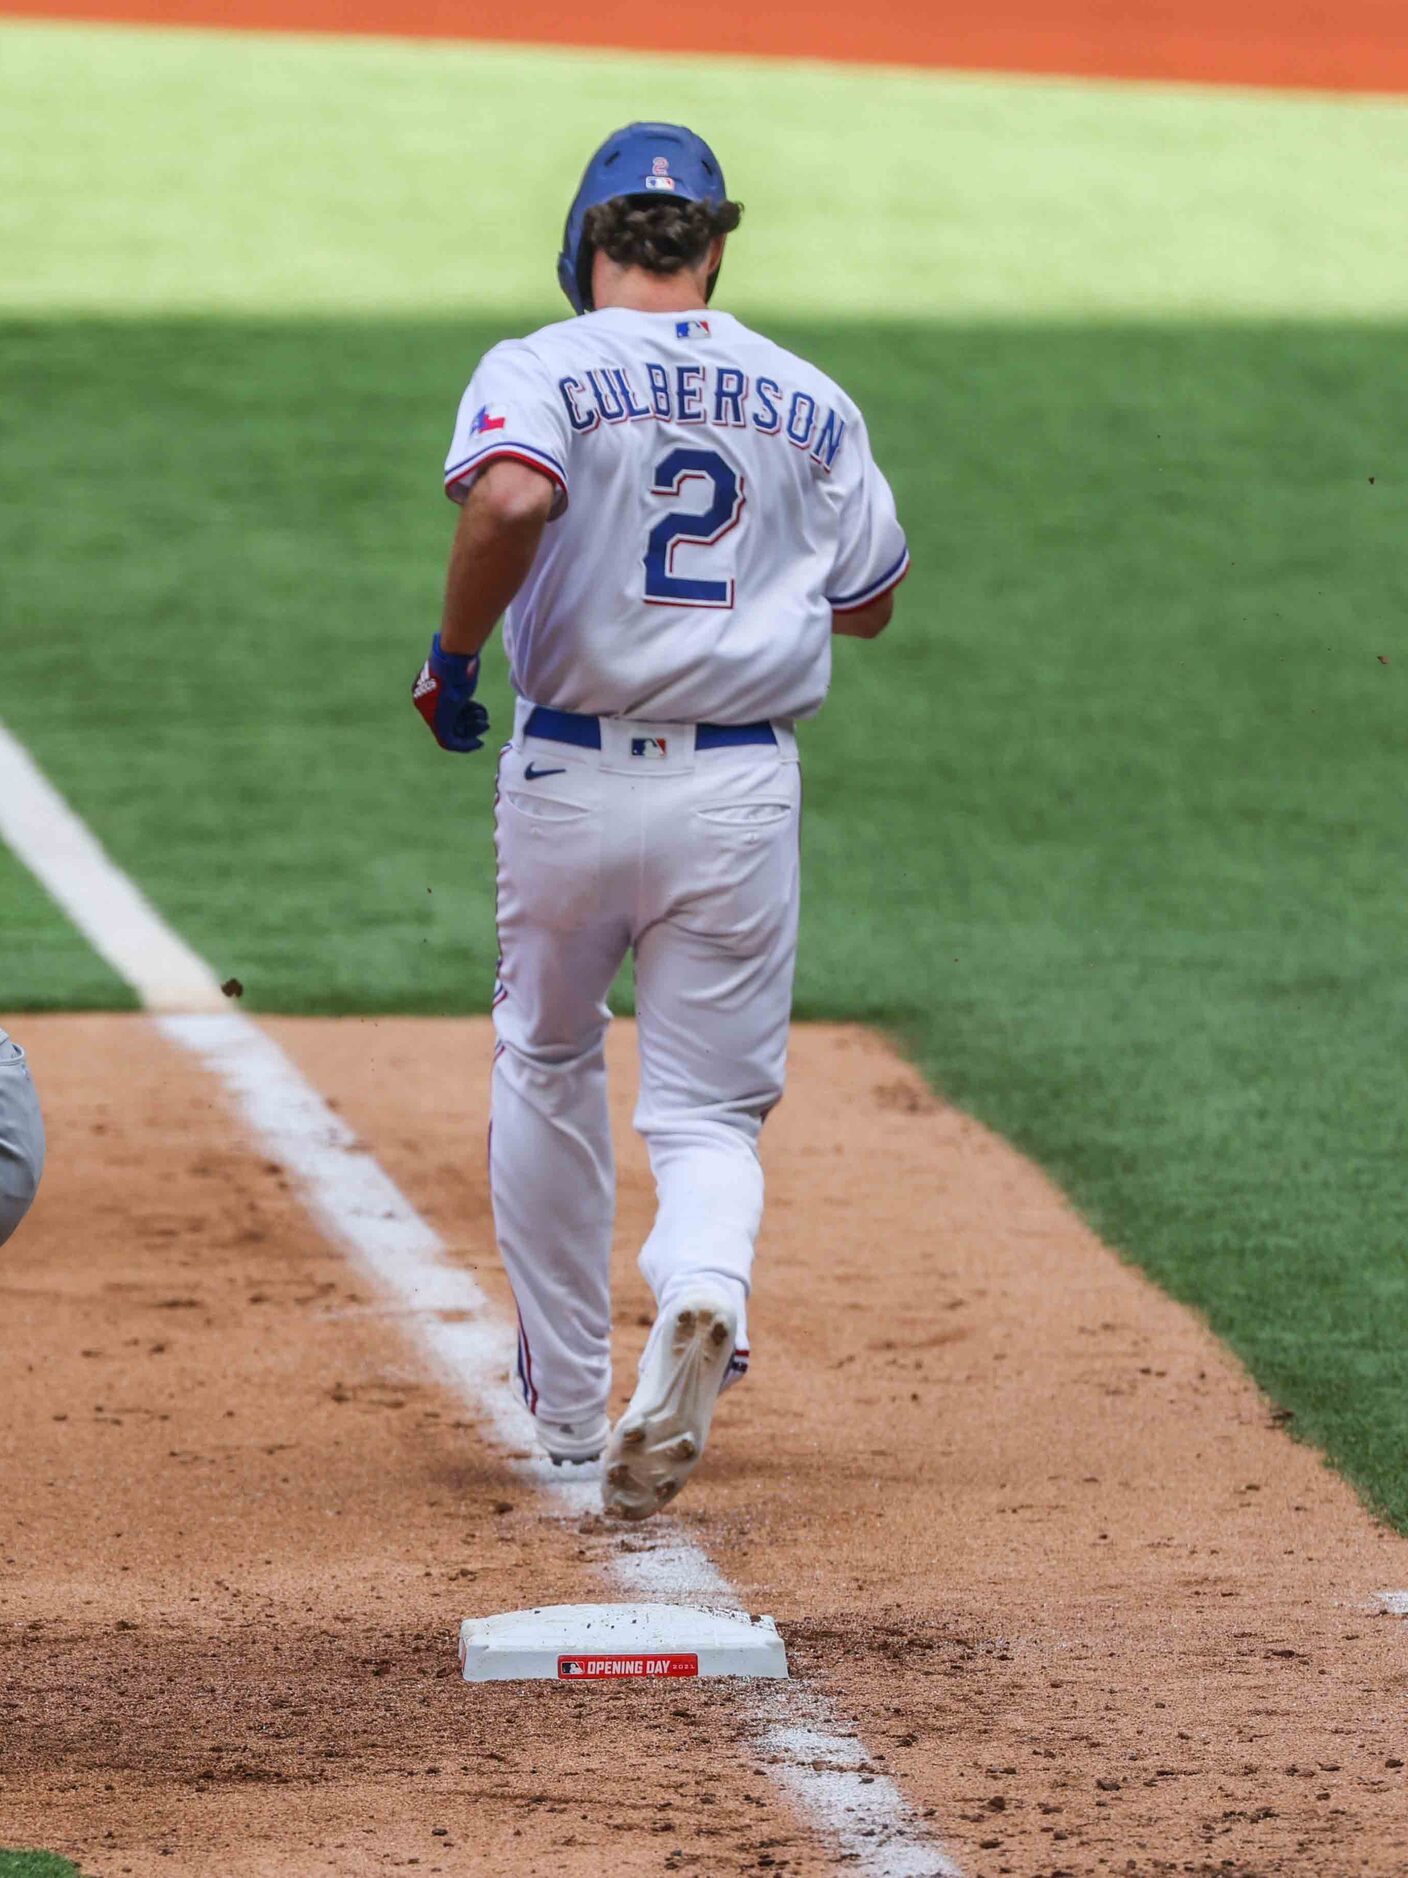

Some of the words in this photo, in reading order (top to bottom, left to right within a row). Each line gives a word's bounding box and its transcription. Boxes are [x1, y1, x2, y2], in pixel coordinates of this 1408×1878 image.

[652, 156, 669, 177] 2
[558, 362, 844, 474] CULBERSON
[642, 446, 746, 609] 2
[587, 1661, 643, 1675] OPENING
[646, 1660, 670, 1674] DAY
